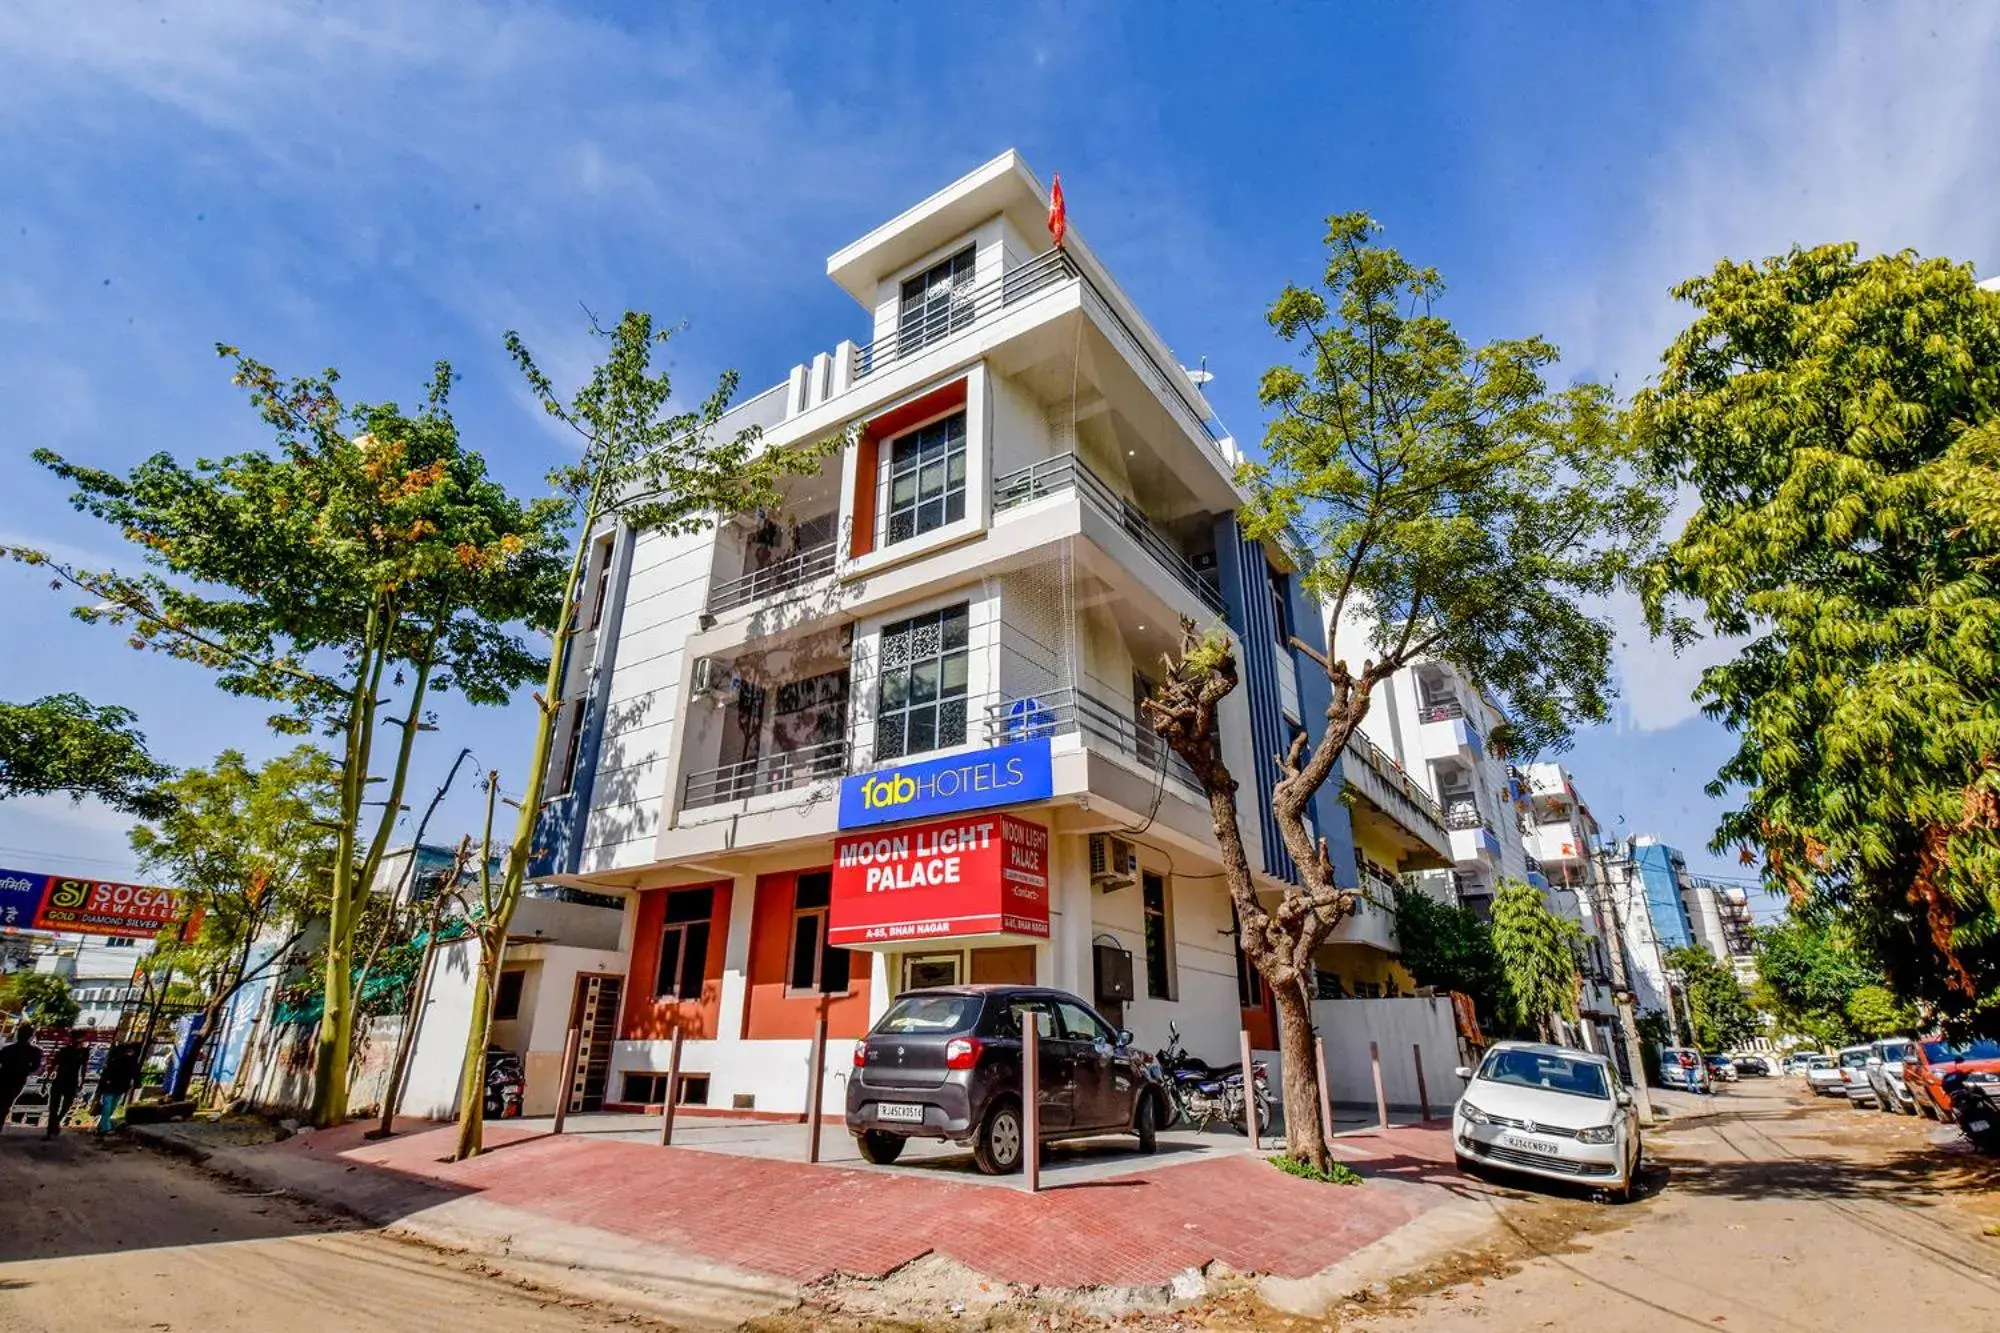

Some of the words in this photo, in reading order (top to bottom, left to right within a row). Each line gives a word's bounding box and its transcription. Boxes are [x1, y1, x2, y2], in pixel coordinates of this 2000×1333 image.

[861, 758, 1024, 809] fabHOTELS
[839, 835, 909, 868] MOON
[917, 823, 994, 857] LIGHT
[1011, 845, 1040, 871] PALACE
[866, 857, 961, 893] PALACE
[48, 911, 76, 921] GOLD
[83, 914, 124, 925] DIAMOND
[126, 918, 159, 928] SILVER
[889, 924, 916, 937] BHAN
[917, 921, 950, 935] NAGAR
